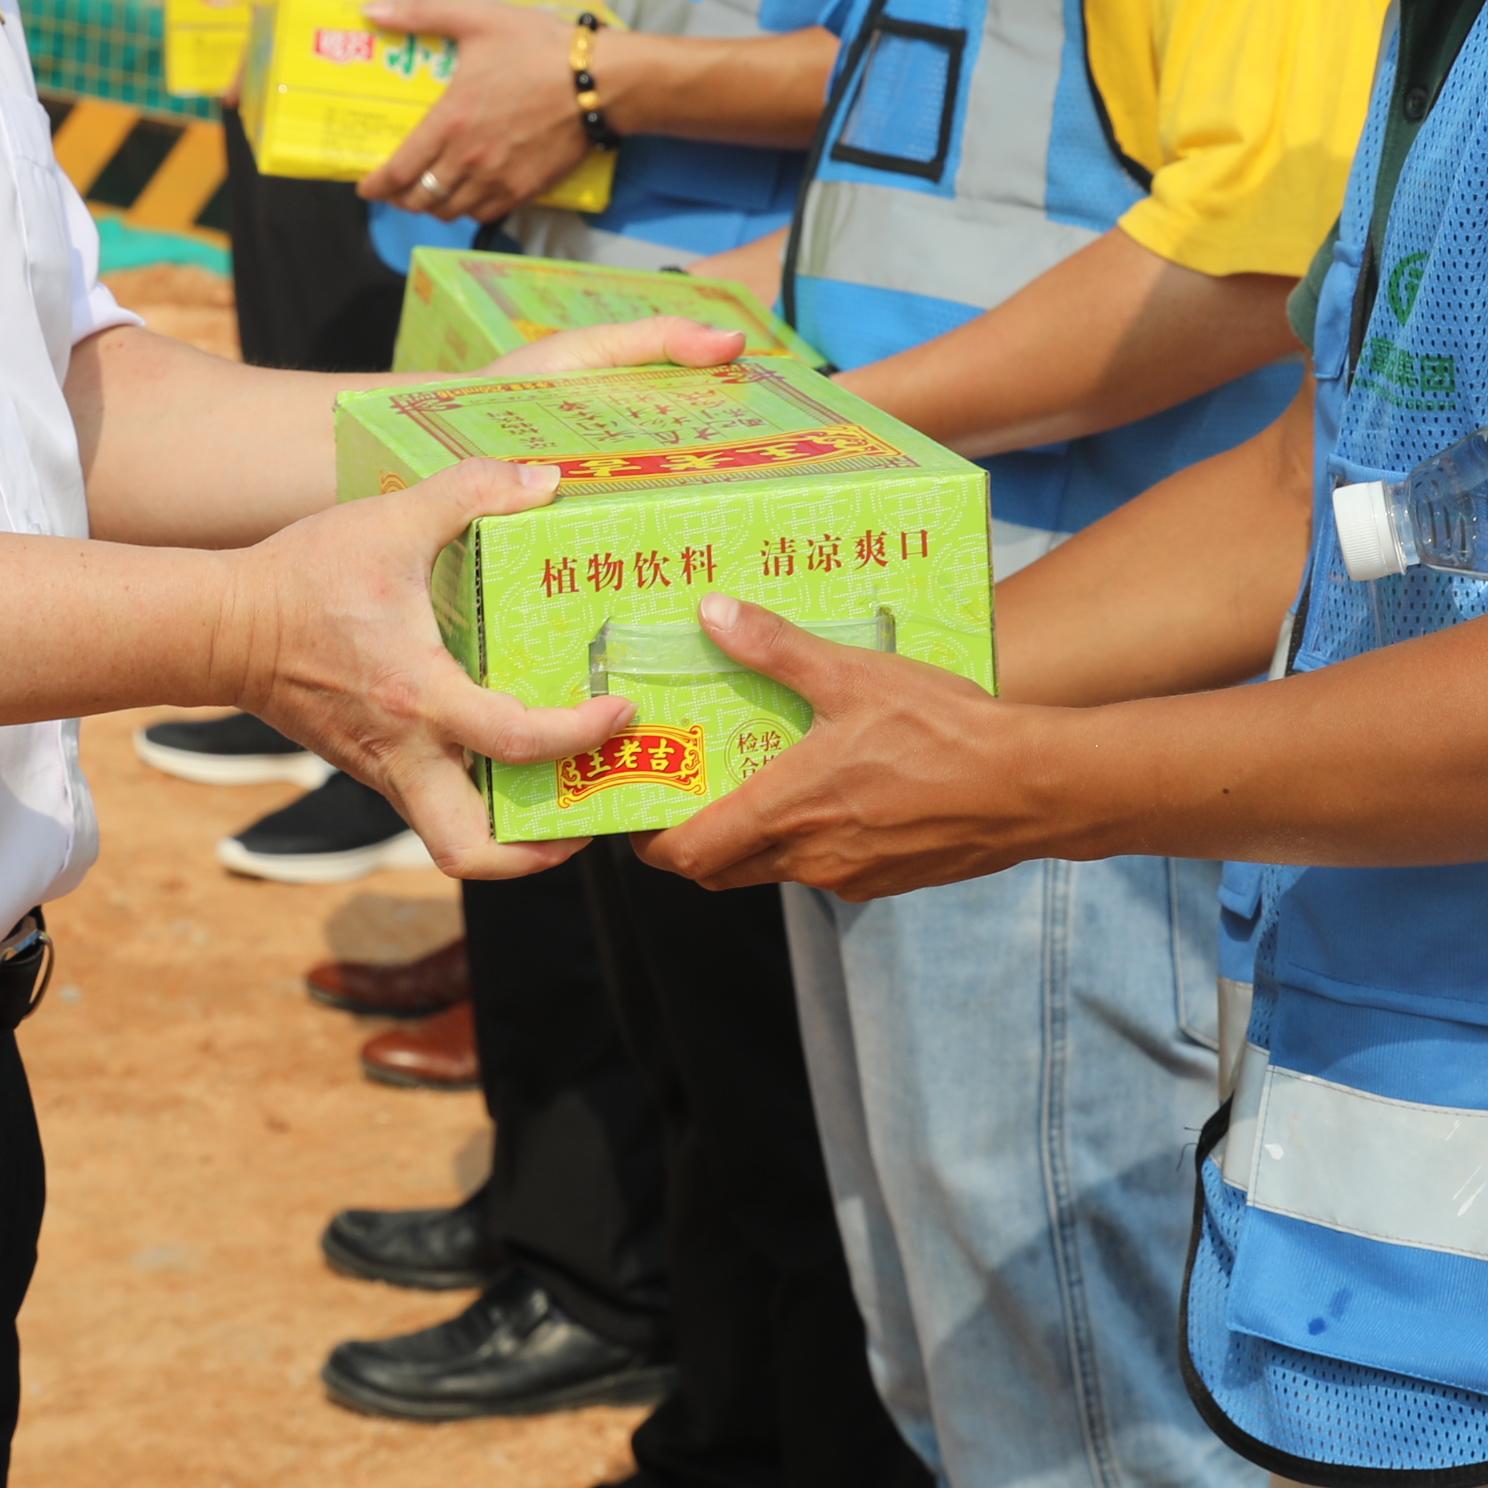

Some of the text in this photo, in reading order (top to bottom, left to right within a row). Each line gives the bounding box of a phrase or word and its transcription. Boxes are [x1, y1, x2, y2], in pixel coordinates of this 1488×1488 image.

[567, 441, 801, 477] 王老吉
[539, 528, 930, 598] 植物饮料 清凉爽口
[586, 737, 676, 779] 王老吉
[737, 731, 782, 755] 检验
